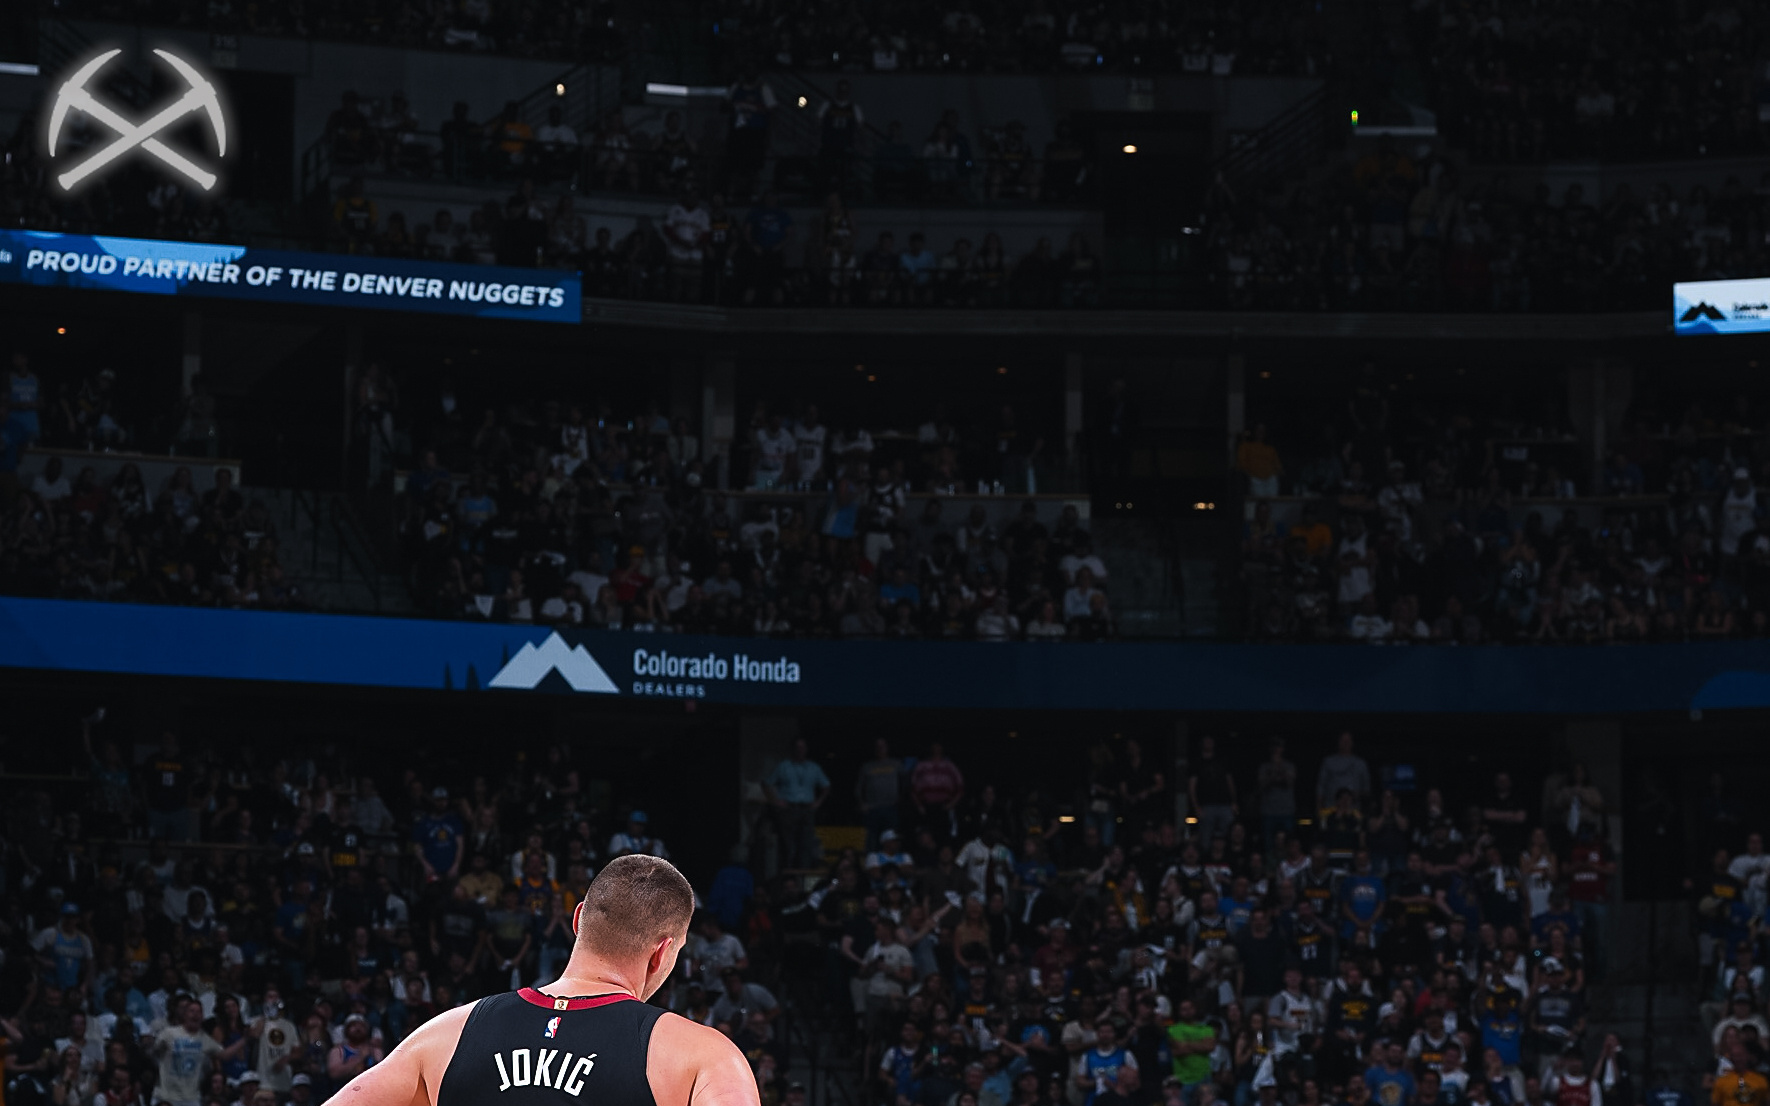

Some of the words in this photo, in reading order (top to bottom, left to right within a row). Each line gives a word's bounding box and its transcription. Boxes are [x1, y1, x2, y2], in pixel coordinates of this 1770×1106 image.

[26, 249, 117, 275] PROUD
[123, 256, 241, 285] PARTNER
[246, 265, 283, 287] OF
[288, 268, 338, 292] THE
[342, 272, 444, 299] DENVER
[449, 280, 565, 308] NUGGETS
[633, 649, 728, 680] Colorado
[733, 654, 800, 682] Honda
[633, 681, 706, 697] DEALERS
[494, 1048, 598, 1097] JOKIĆ
